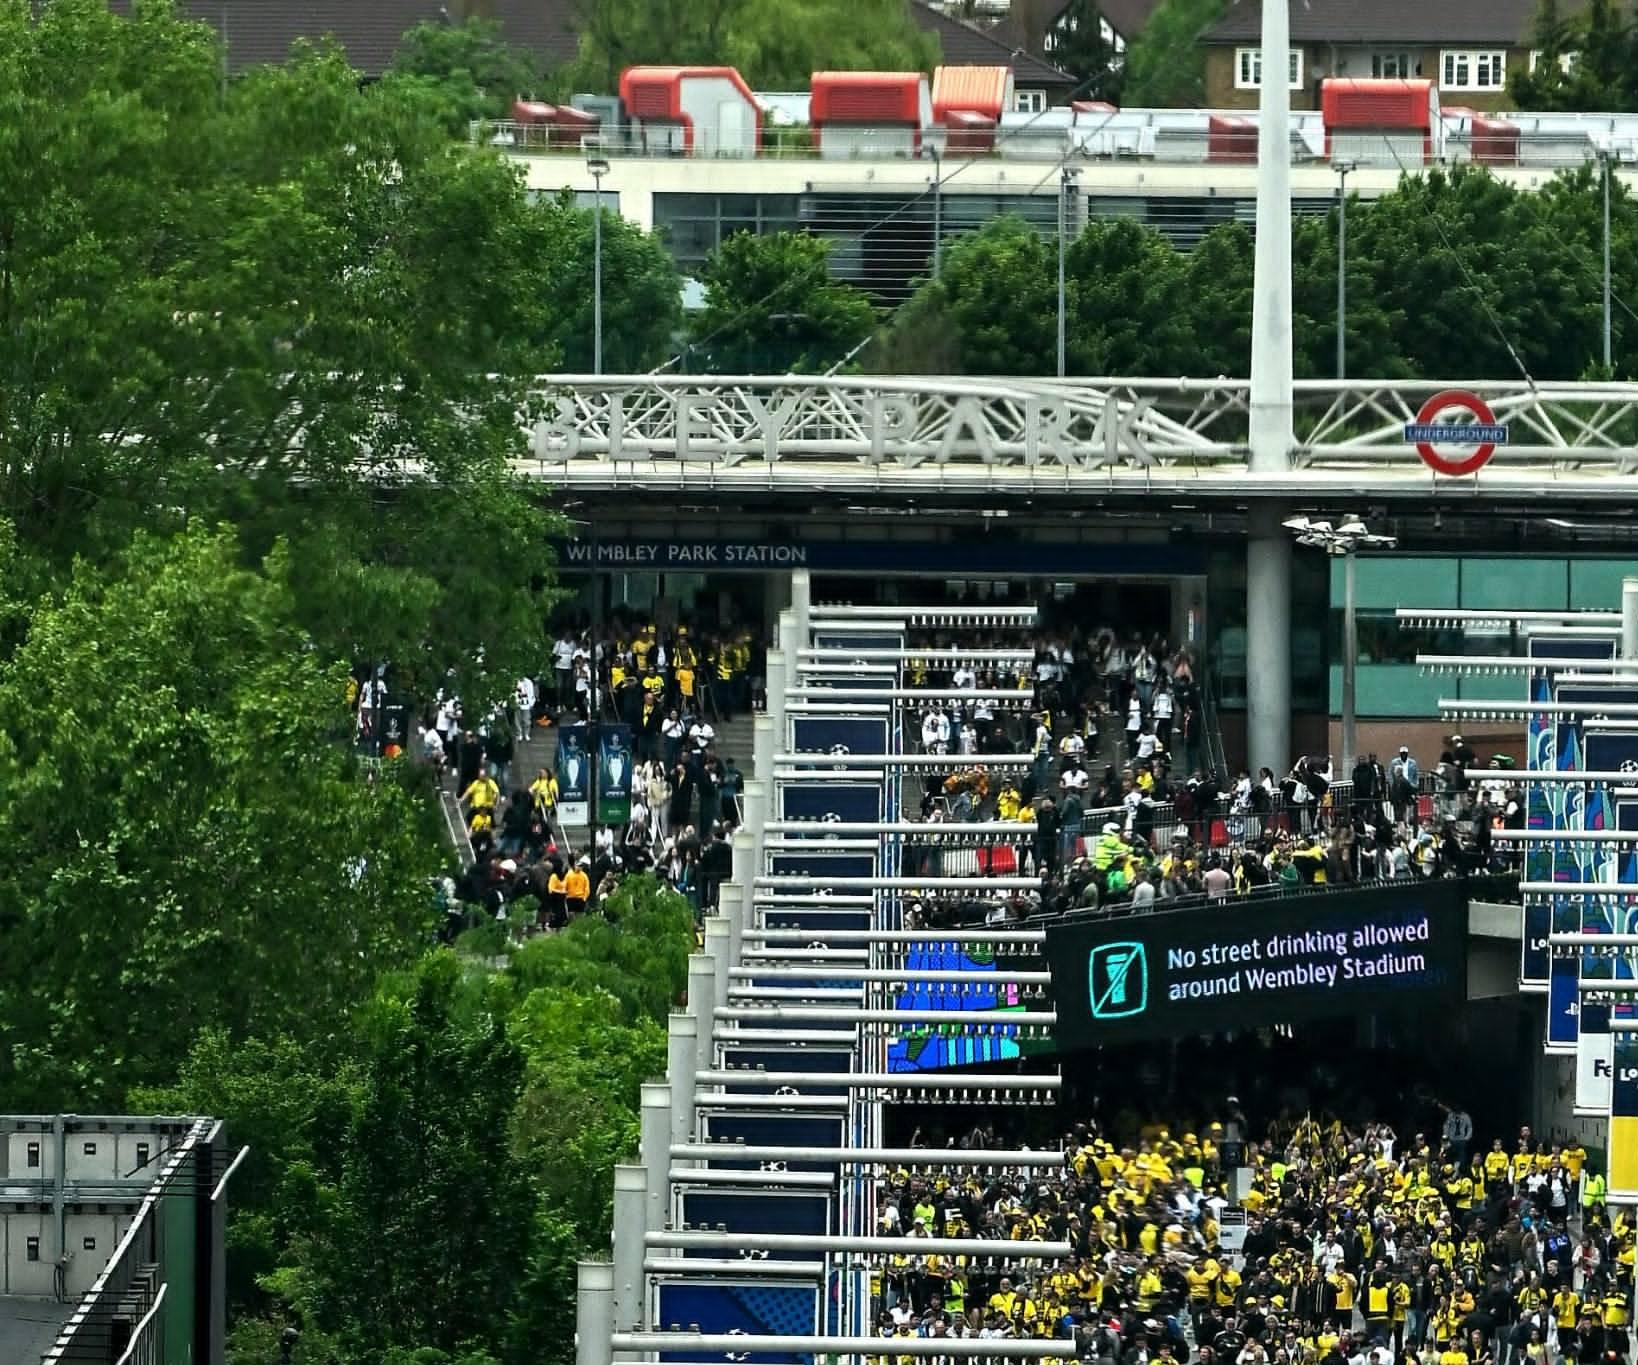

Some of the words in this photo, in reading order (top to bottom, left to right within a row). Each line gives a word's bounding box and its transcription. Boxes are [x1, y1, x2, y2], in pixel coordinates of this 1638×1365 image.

[535, 396, 800, 461] BLEY
[1408, 427, 1503, 440] UNDERGROUND
[668, 545, 718, 561] PARK
[725, 545, 806, 561] STATION
[1167, 948, 1195, 970] No
[1201, 938, 1261, 966] street
[1267, 928, 1347, 958] drinking
[1353, 917, 1429, 948] allowed
[1168, 974, 1240, 1001] around
[1245, 962, 1337, 990] Wembley
[1343, 950, 1425, 979] Stadium
